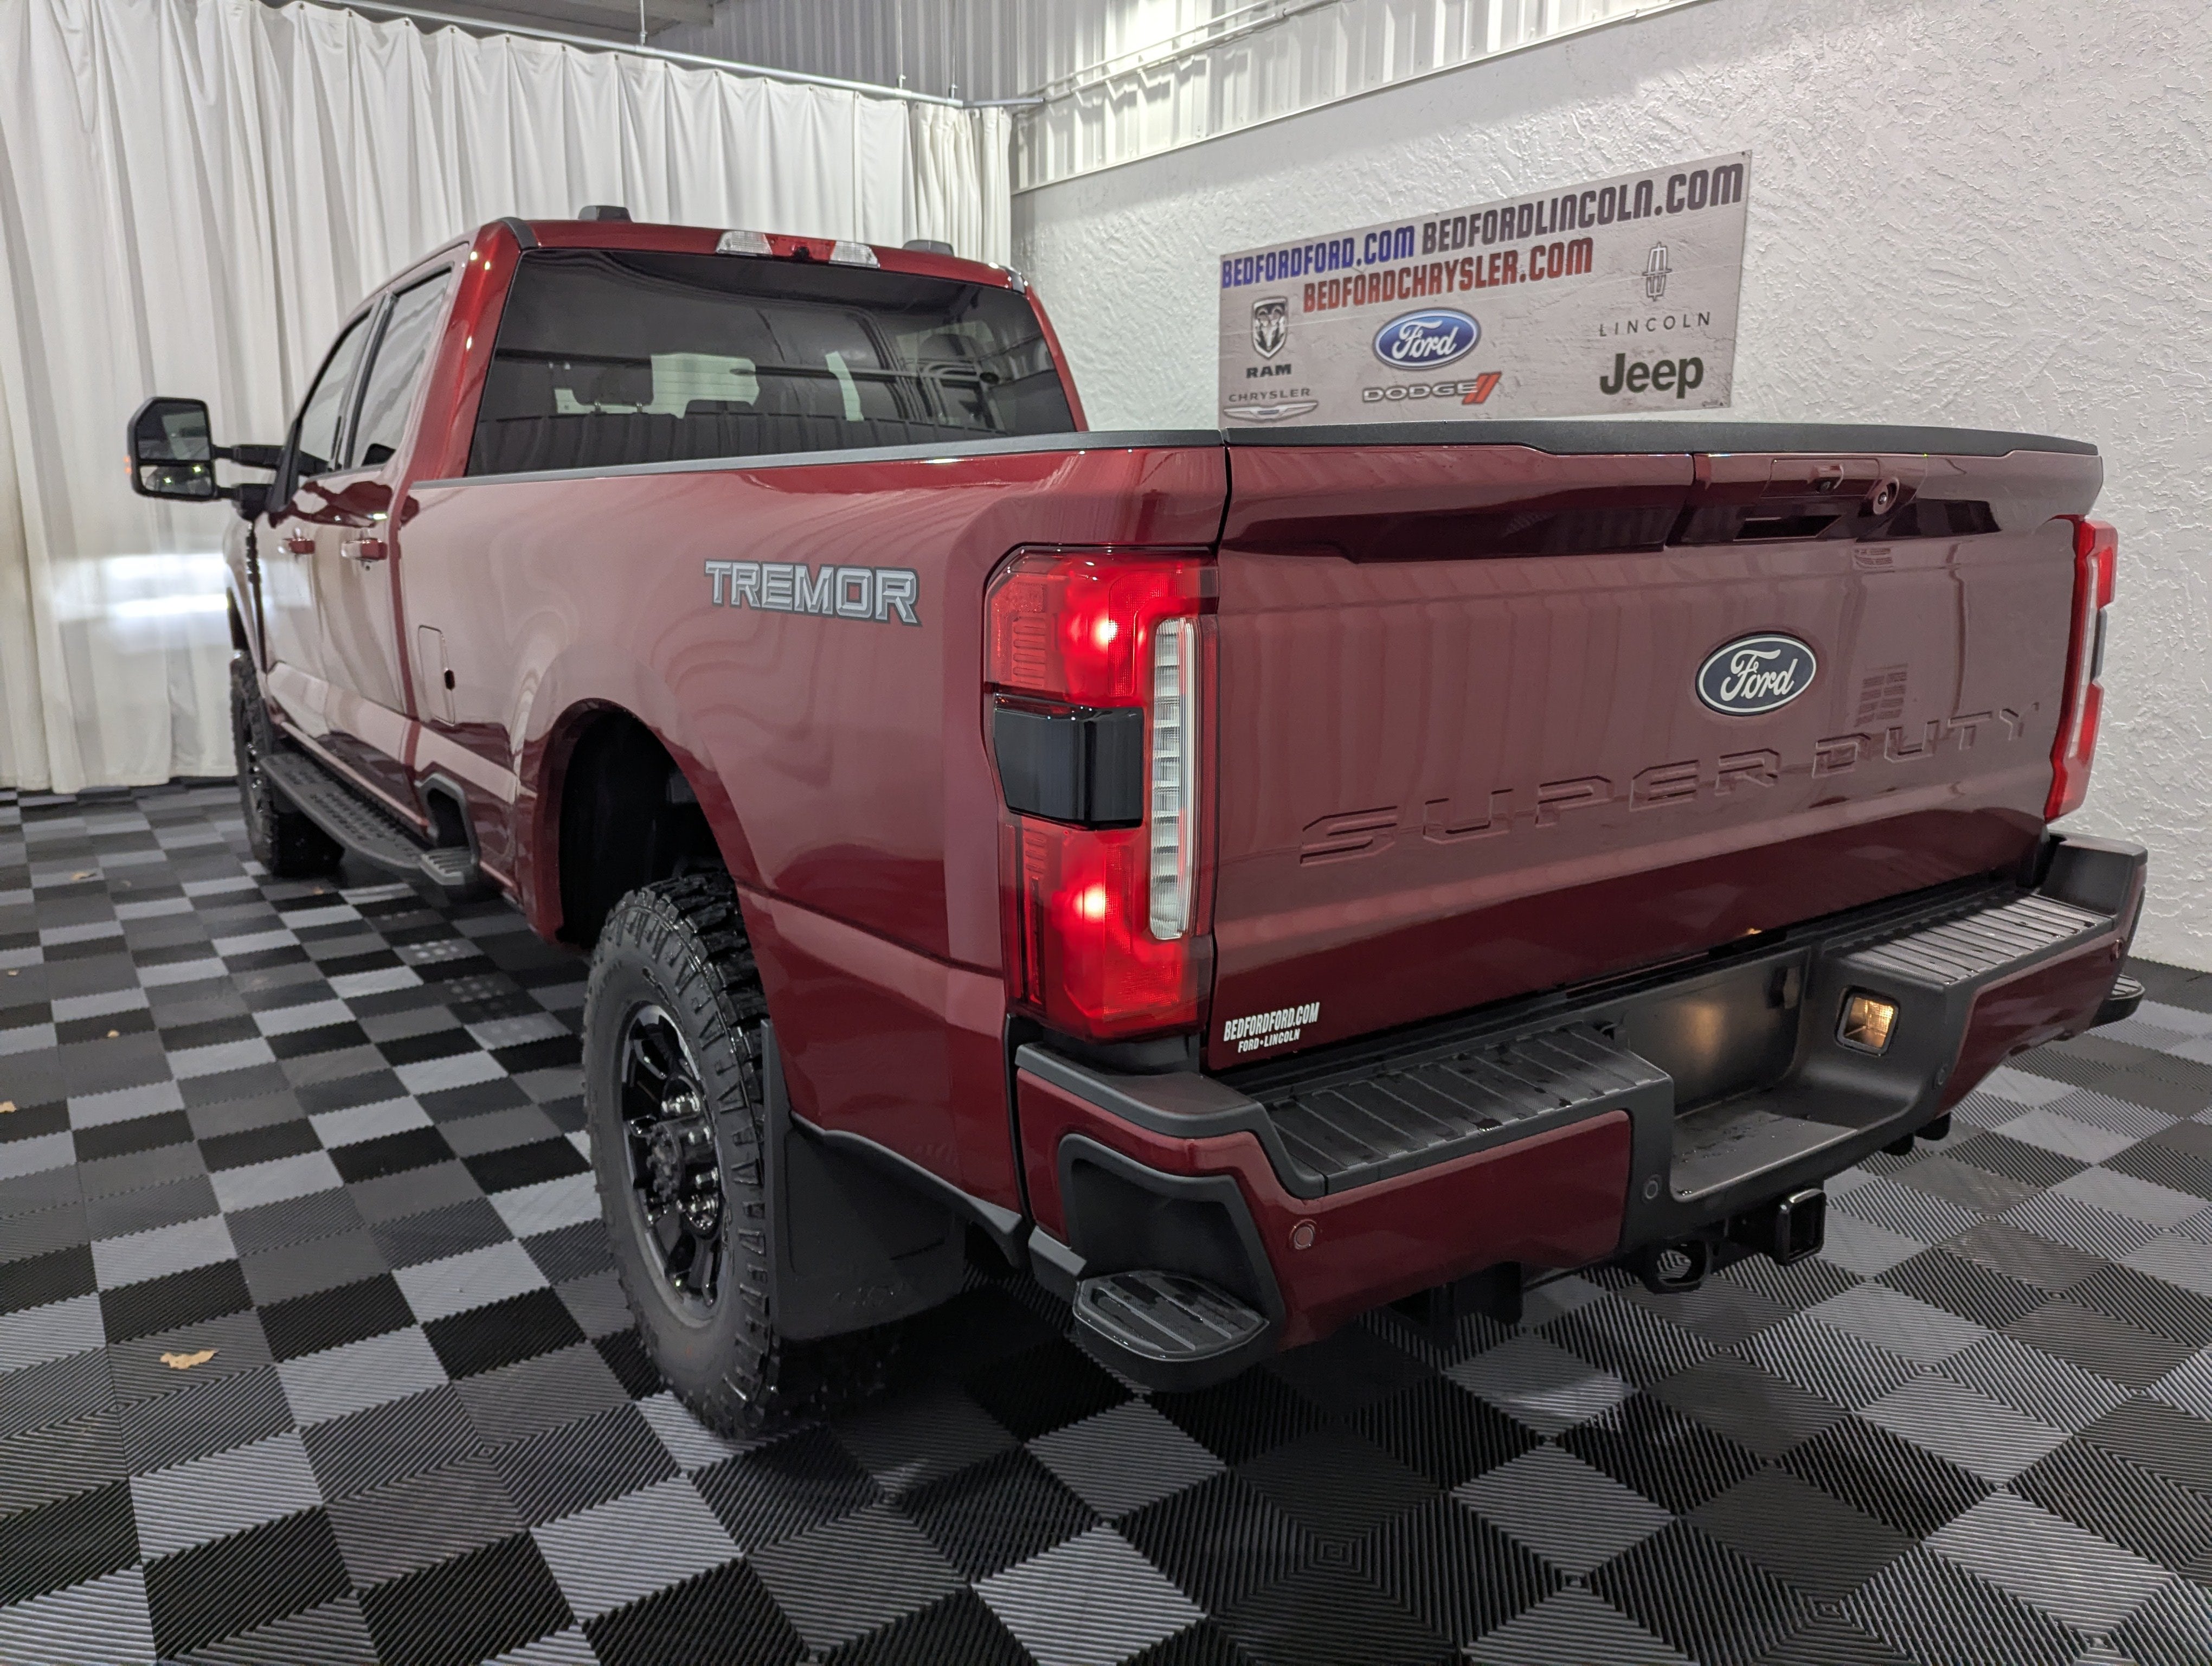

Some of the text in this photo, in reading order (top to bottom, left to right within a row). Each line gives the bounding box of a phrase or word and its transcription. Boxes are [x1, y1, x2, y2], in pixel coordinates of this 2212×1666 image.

[1221, 163, 1744, 289] BEDFORDFORD.COM BEDFORDLINCOLN.COM
[1303, 237, 1593, 313] BEDFORDCHRYSLER.COM
[1392, 320, 1459, 360] Ford
[1600, 311, 1710, 337] LINCOLN
[1246, 364, 1291, 379] RAM
[1362, 380, 1478, 402] DODGE
[1600, 353, 1703, 399] Jeep
[1229, 388, 1310, 402] CHRYSLER
[704, 559, 922, 626] TREMOR
[1720, 649, 1798, 701] Ford
[1300, 702, 2040, 866] SUPER DUTY
[1223, 1002, 1320, 1042] BEDFORDFORD.COM
